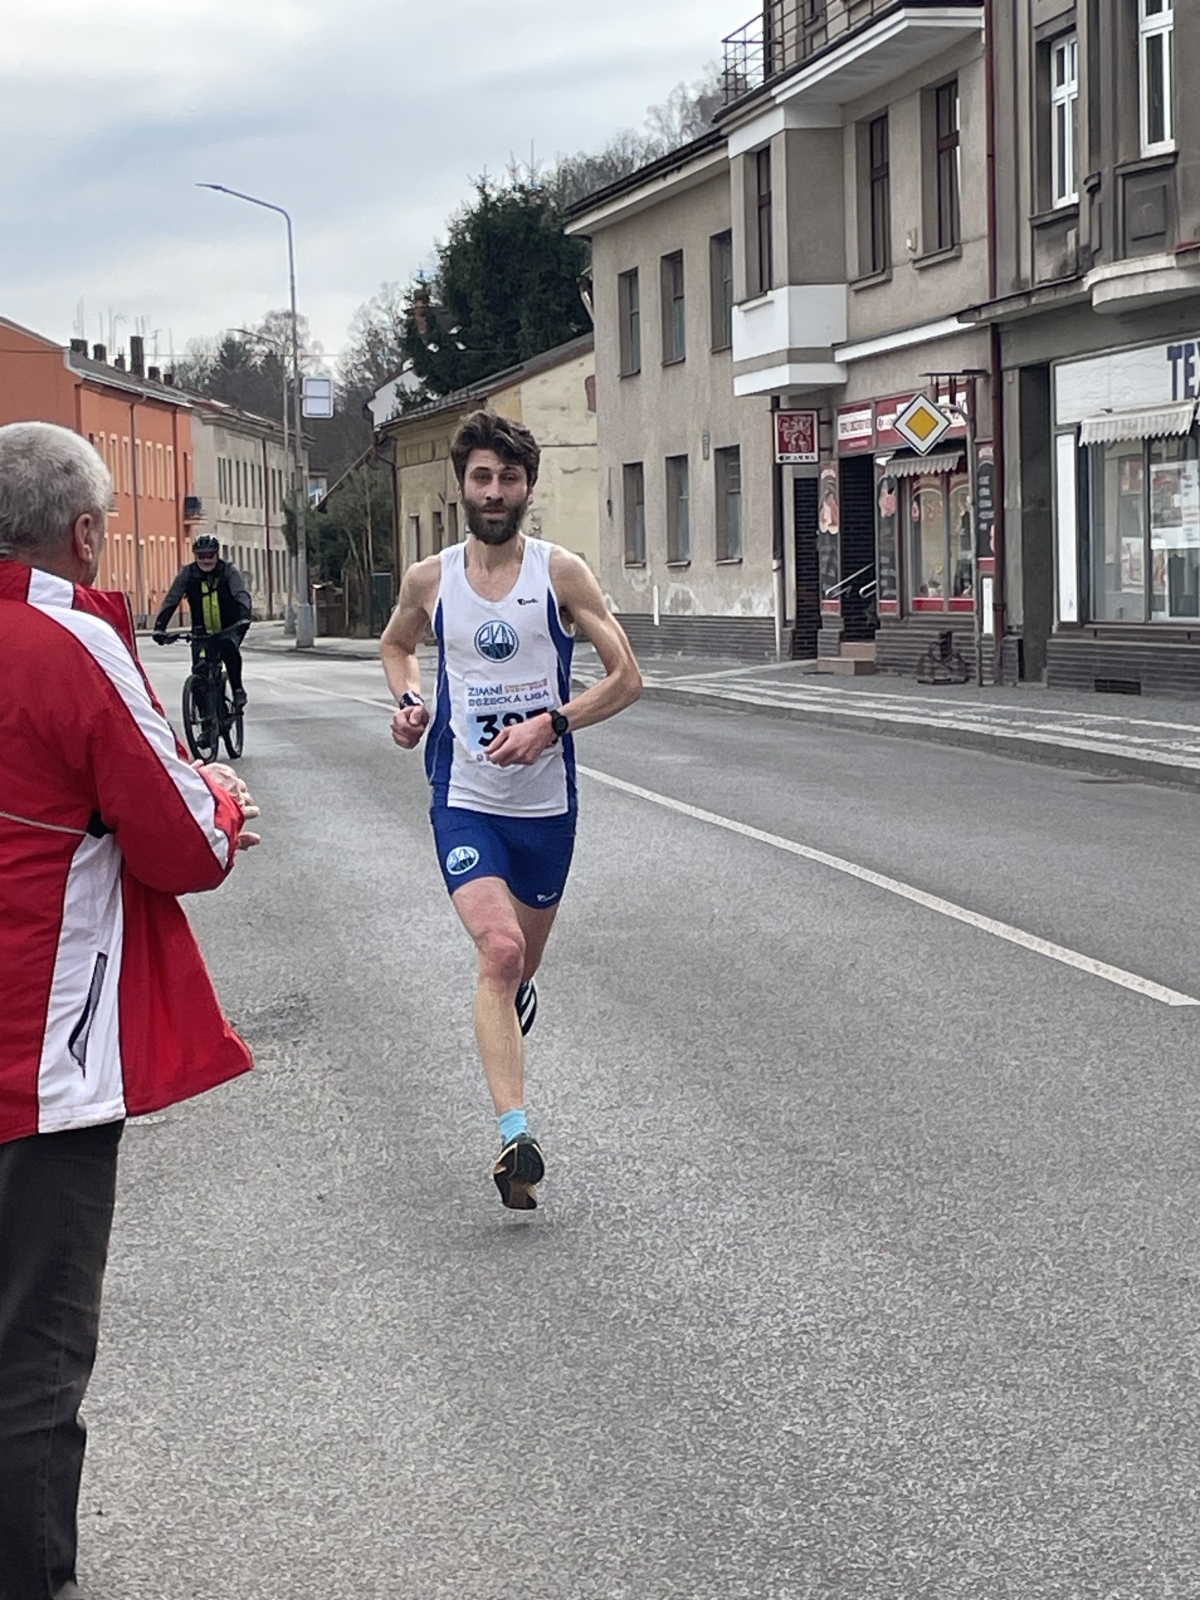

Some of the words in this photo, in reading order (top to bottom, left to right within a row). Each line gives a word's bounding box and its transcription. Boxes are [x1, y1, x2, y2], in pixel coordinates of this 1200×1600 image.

[1167, 342, 1200, 401] TE
[467, 683, 503, 697] ZIMNÍ
[524, 689, 550, 702] LIGA
